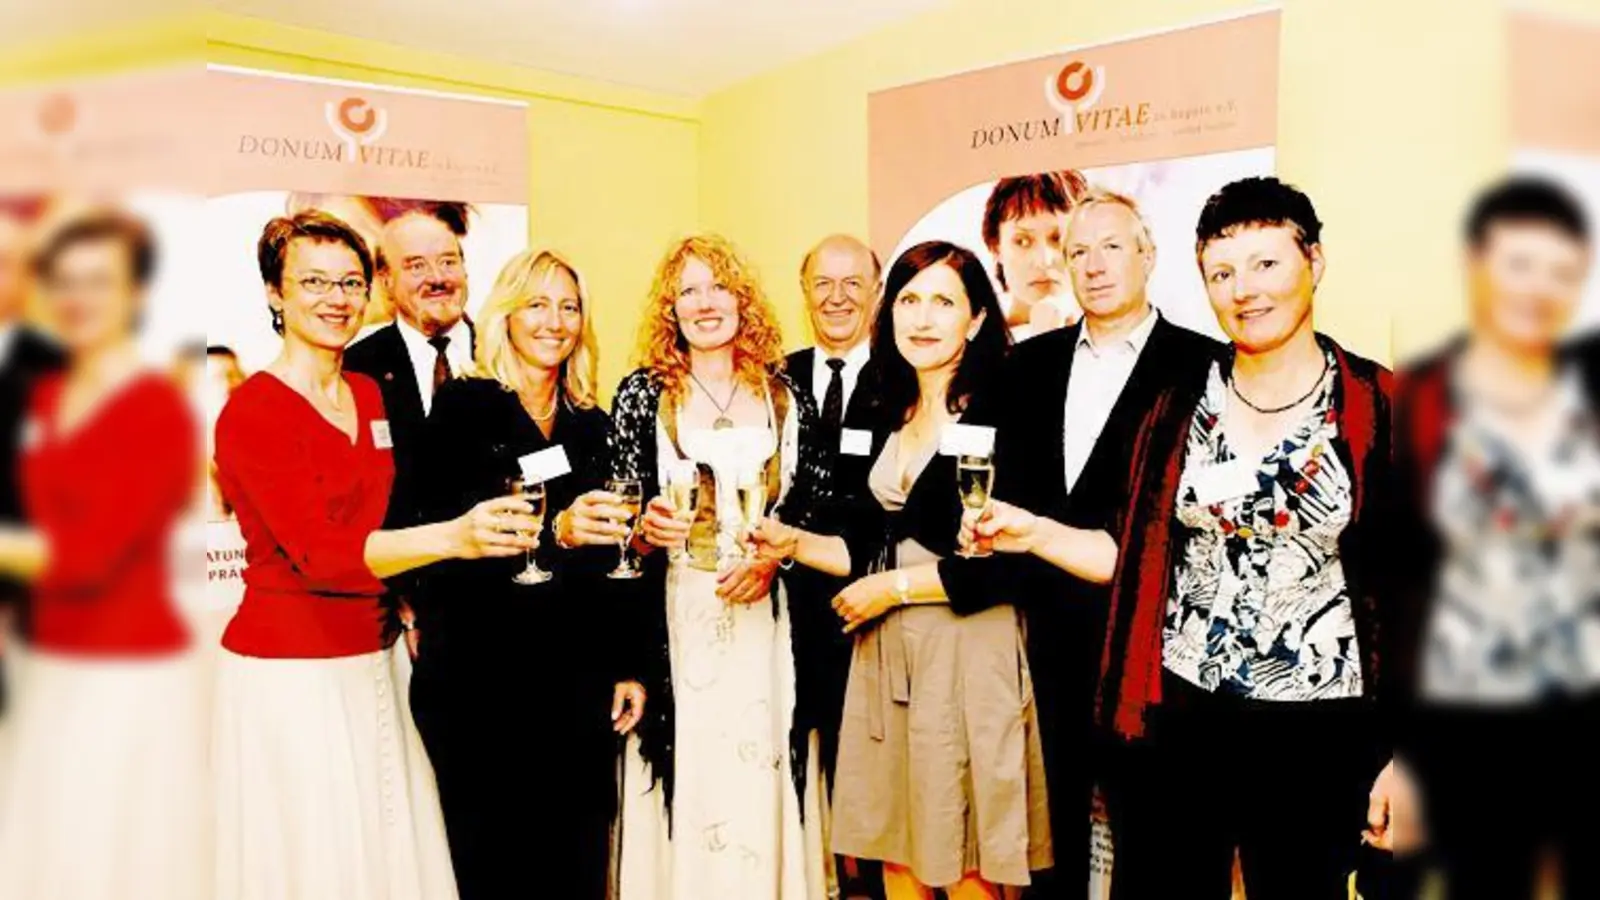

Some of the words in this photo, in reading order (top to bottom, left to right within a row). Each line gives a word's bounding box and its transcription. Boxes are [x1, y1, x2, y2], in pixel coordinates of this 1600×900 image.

[970, 117, 1060, 149] DONUM
[1074, 102, 1151, 134] VITAE
[238, 134, 342, 162] DONUM
[359, 144, 430, 170] VITAE
